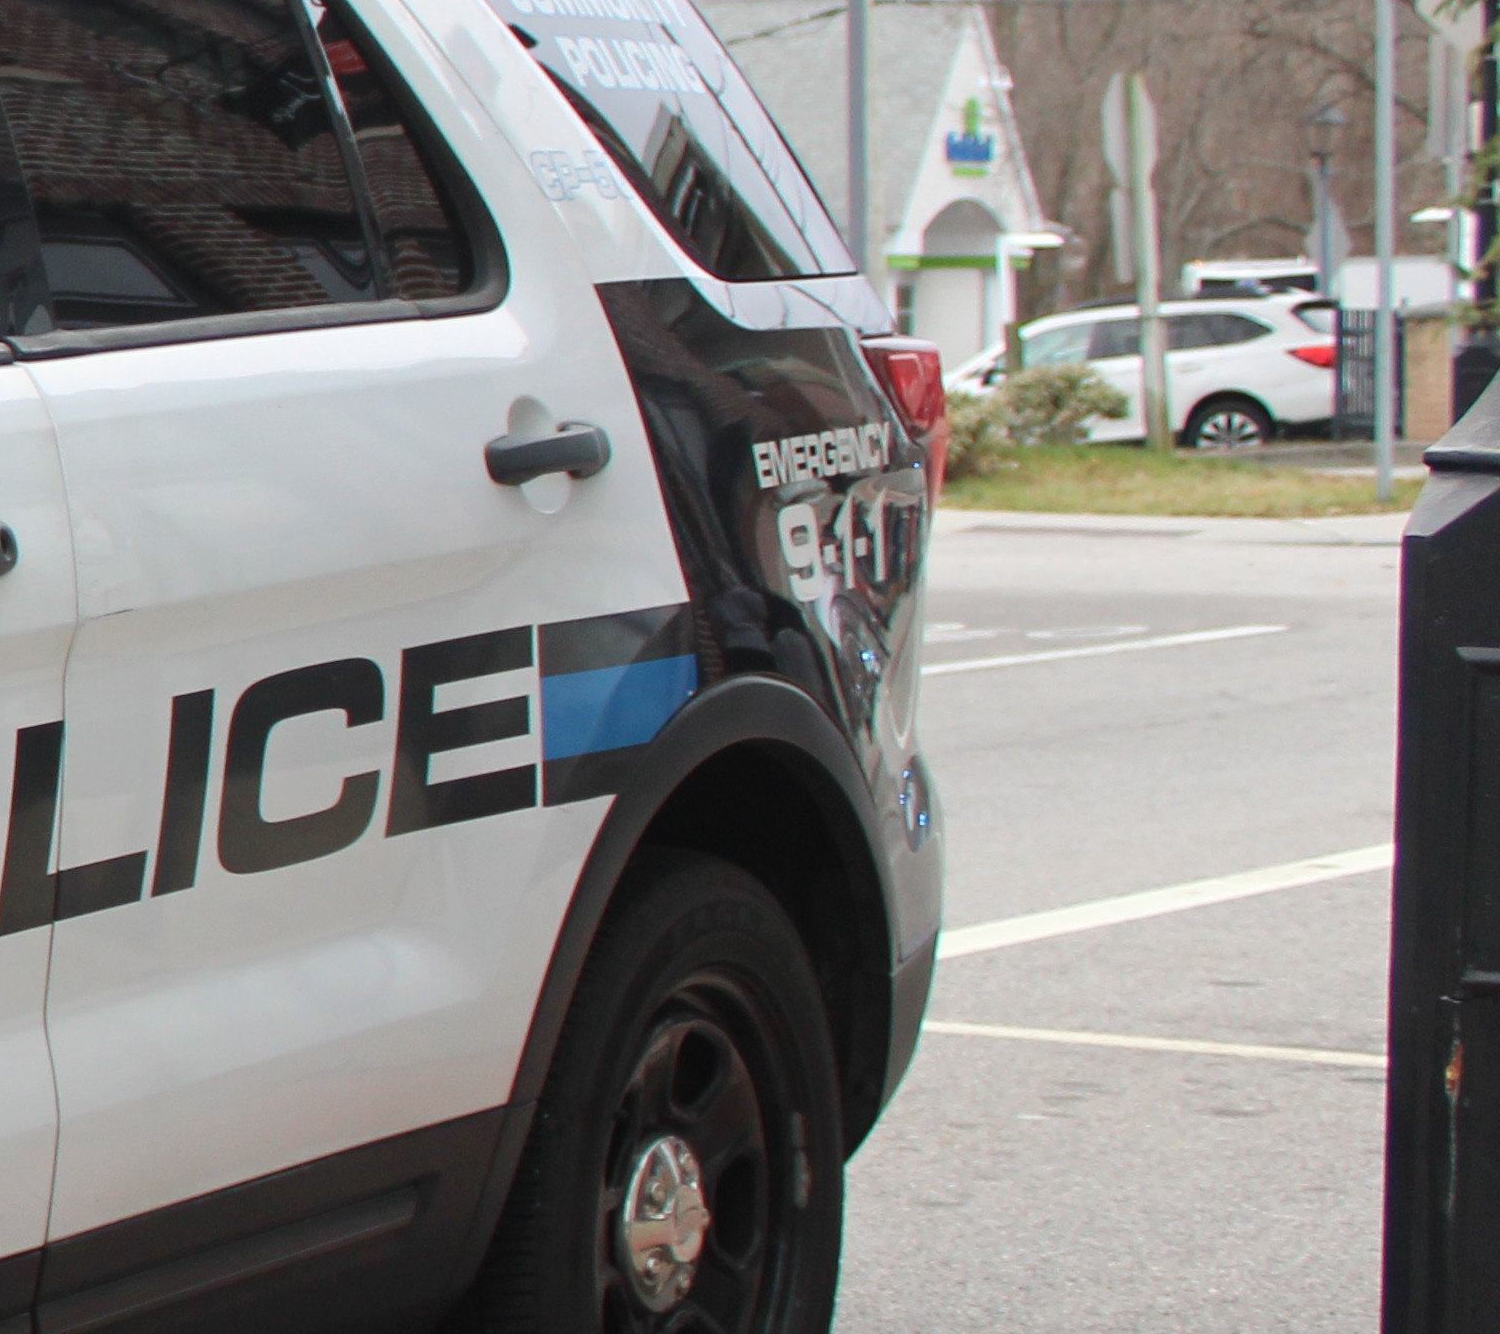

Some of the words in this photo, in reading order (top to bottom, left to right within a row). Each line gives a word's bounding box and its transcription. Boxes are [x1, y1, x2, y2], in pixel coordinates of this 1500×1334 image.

[554, 35, 707, 94] POLICING
[530, 150, 631, 202] CP-5
[752, 421, 891, 489] EMERGENCY
